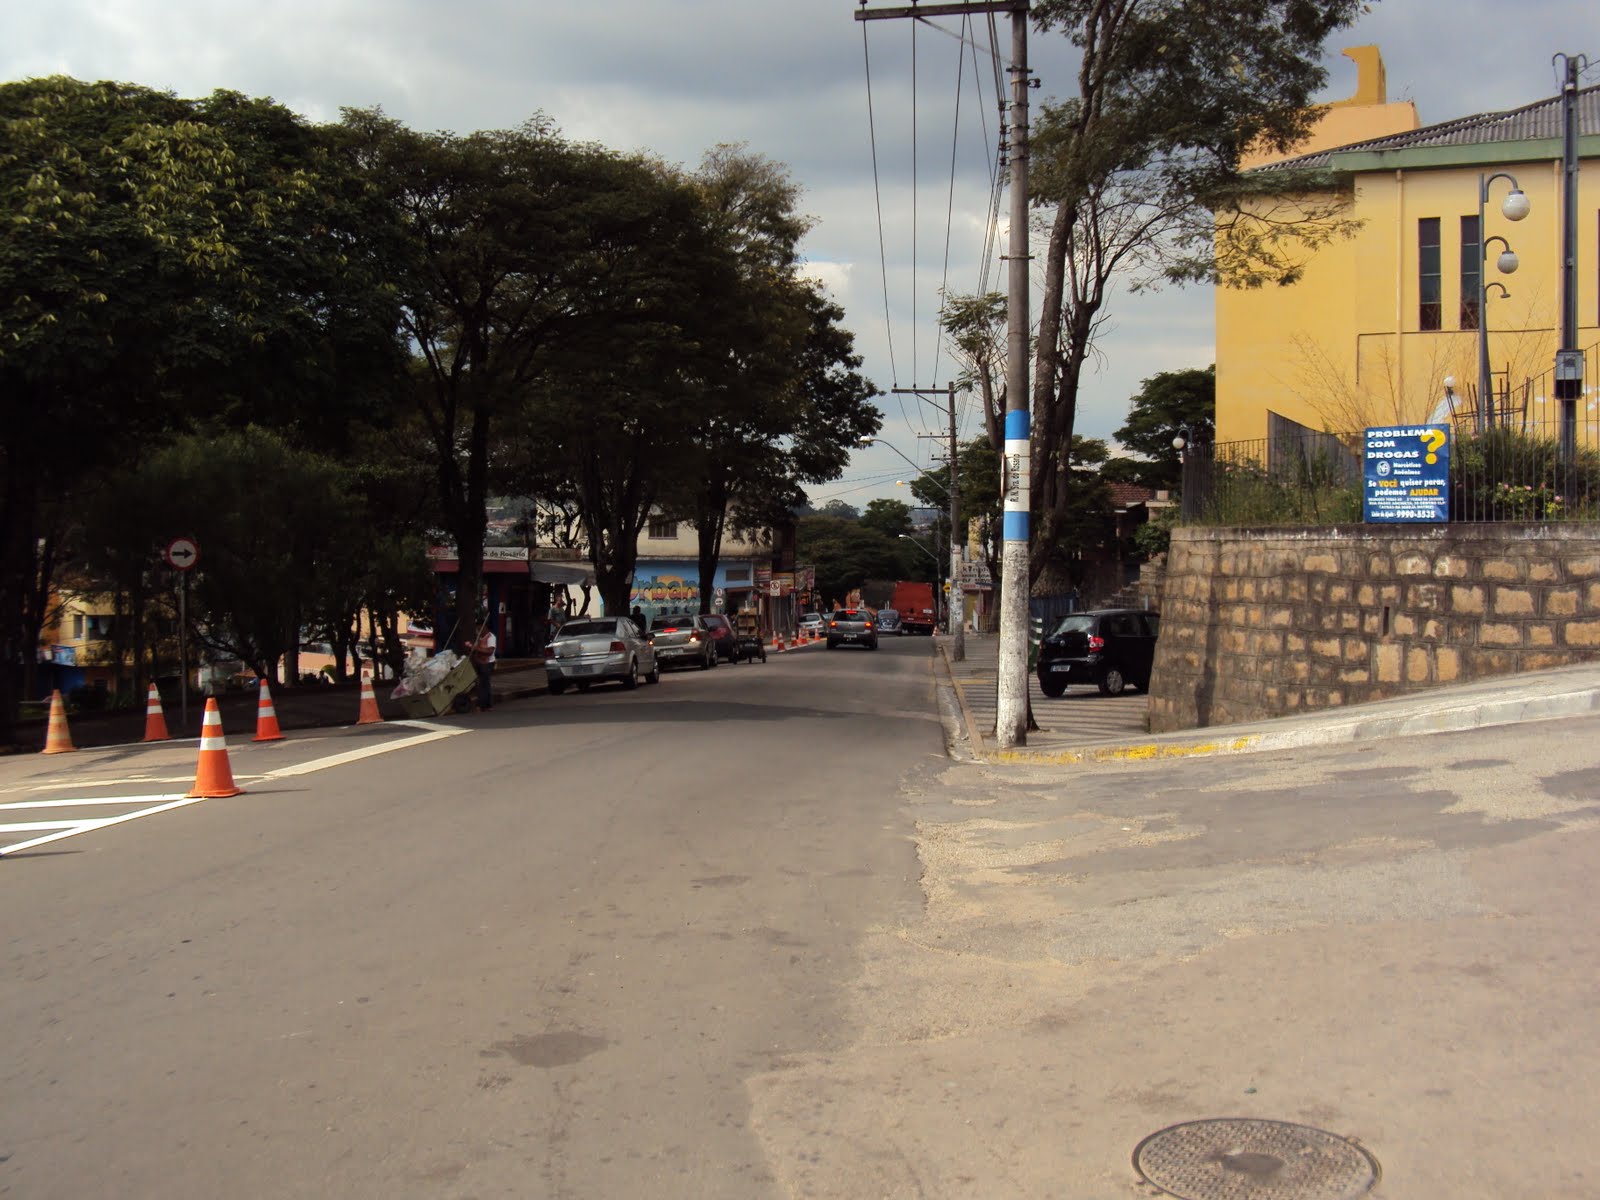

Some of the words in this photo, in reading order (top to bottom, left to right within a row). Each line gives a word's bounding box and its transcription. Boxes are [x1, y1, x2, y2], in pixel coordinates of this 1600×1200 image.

[1367, 428, 1433, 438] PROBLEMA
[1367, 450, 1420, 459] DROGAS
[1400, 478, 1422, 488] quiser
[1375, 488, 1406, 497] podemos
